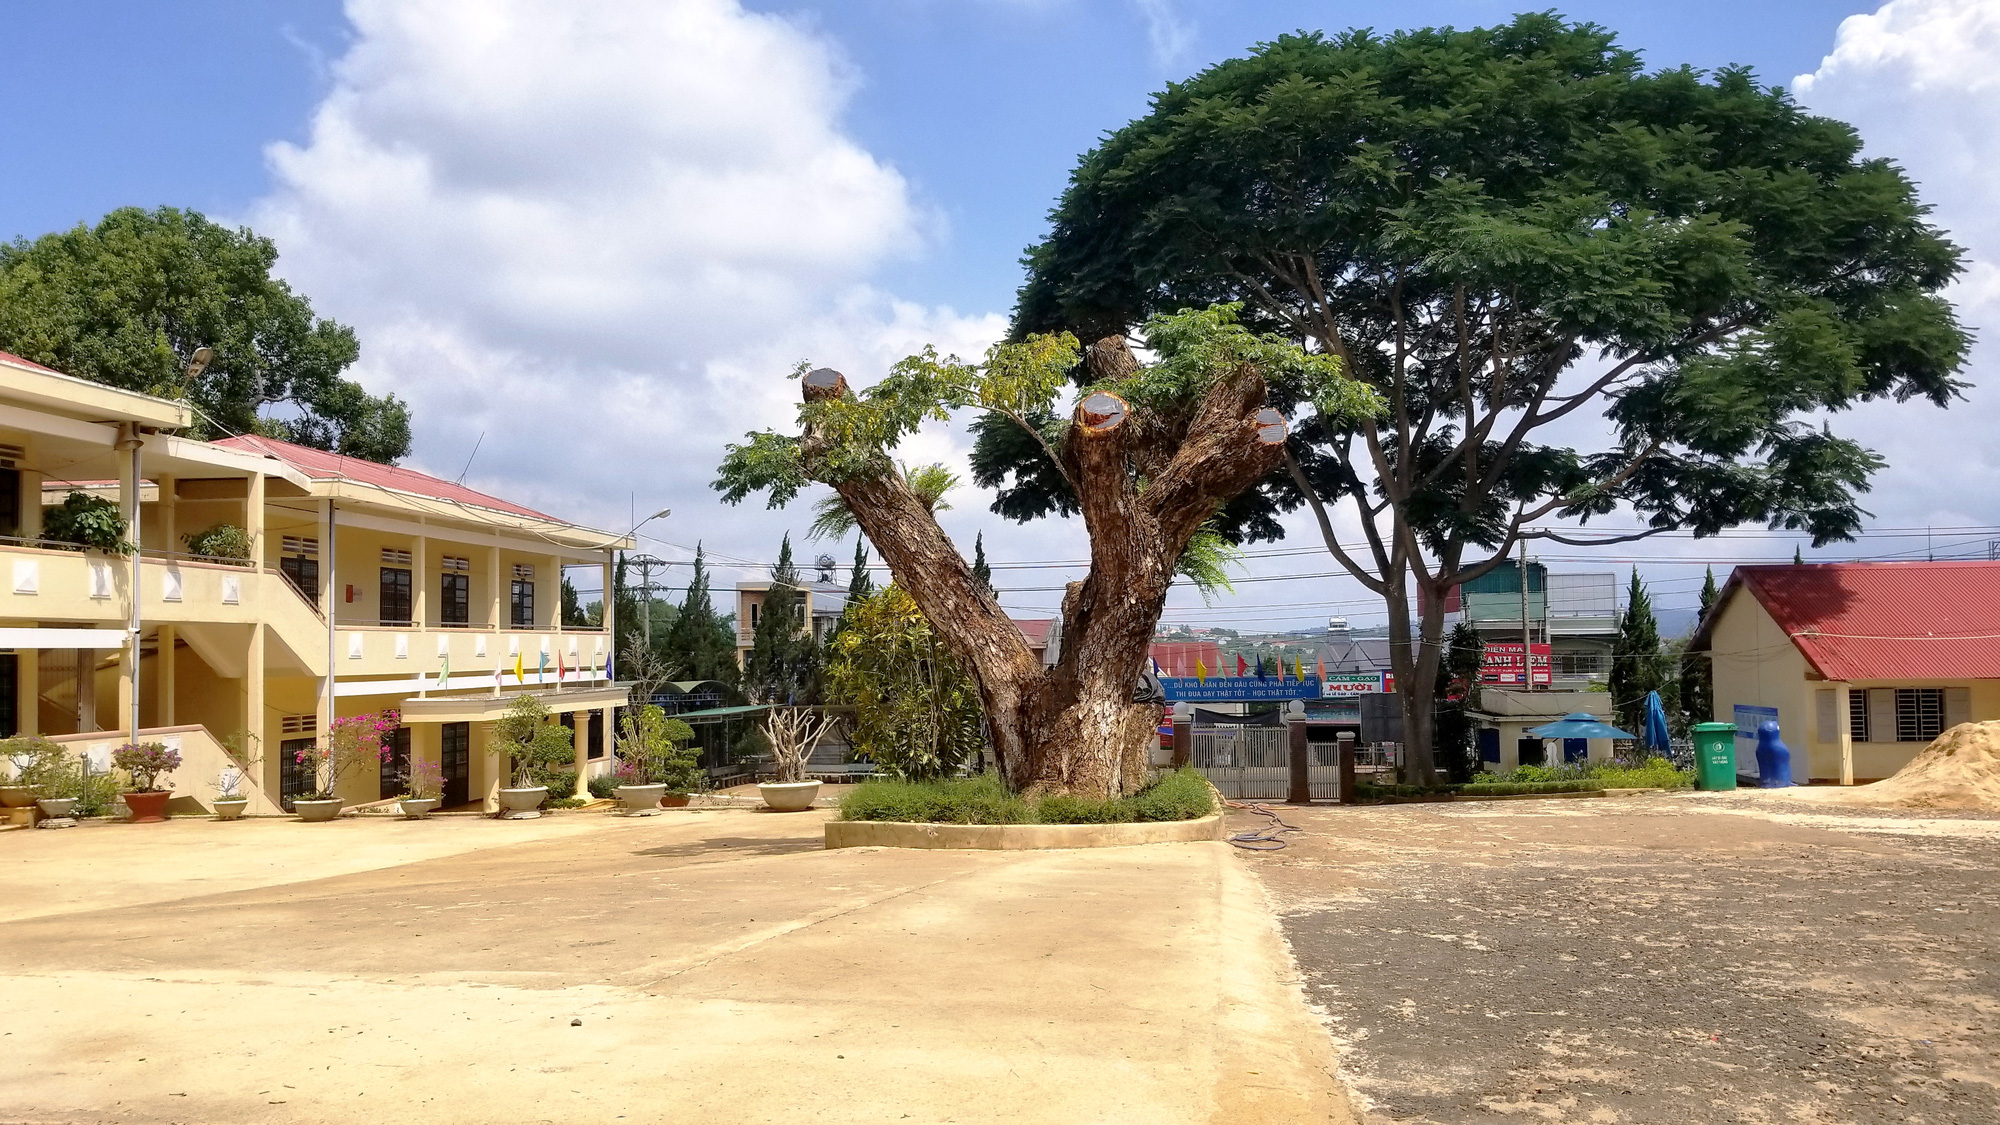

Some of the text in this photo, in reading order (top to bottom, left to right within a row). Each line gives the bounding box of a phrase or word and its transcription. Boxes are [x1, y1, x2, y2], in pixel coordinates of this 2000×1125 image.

[1329, 683, 1373, 691] MƯỜI
[1234, 689, 1245, 697] TỐT
[1252, 690, 1266, 698] HỌC
